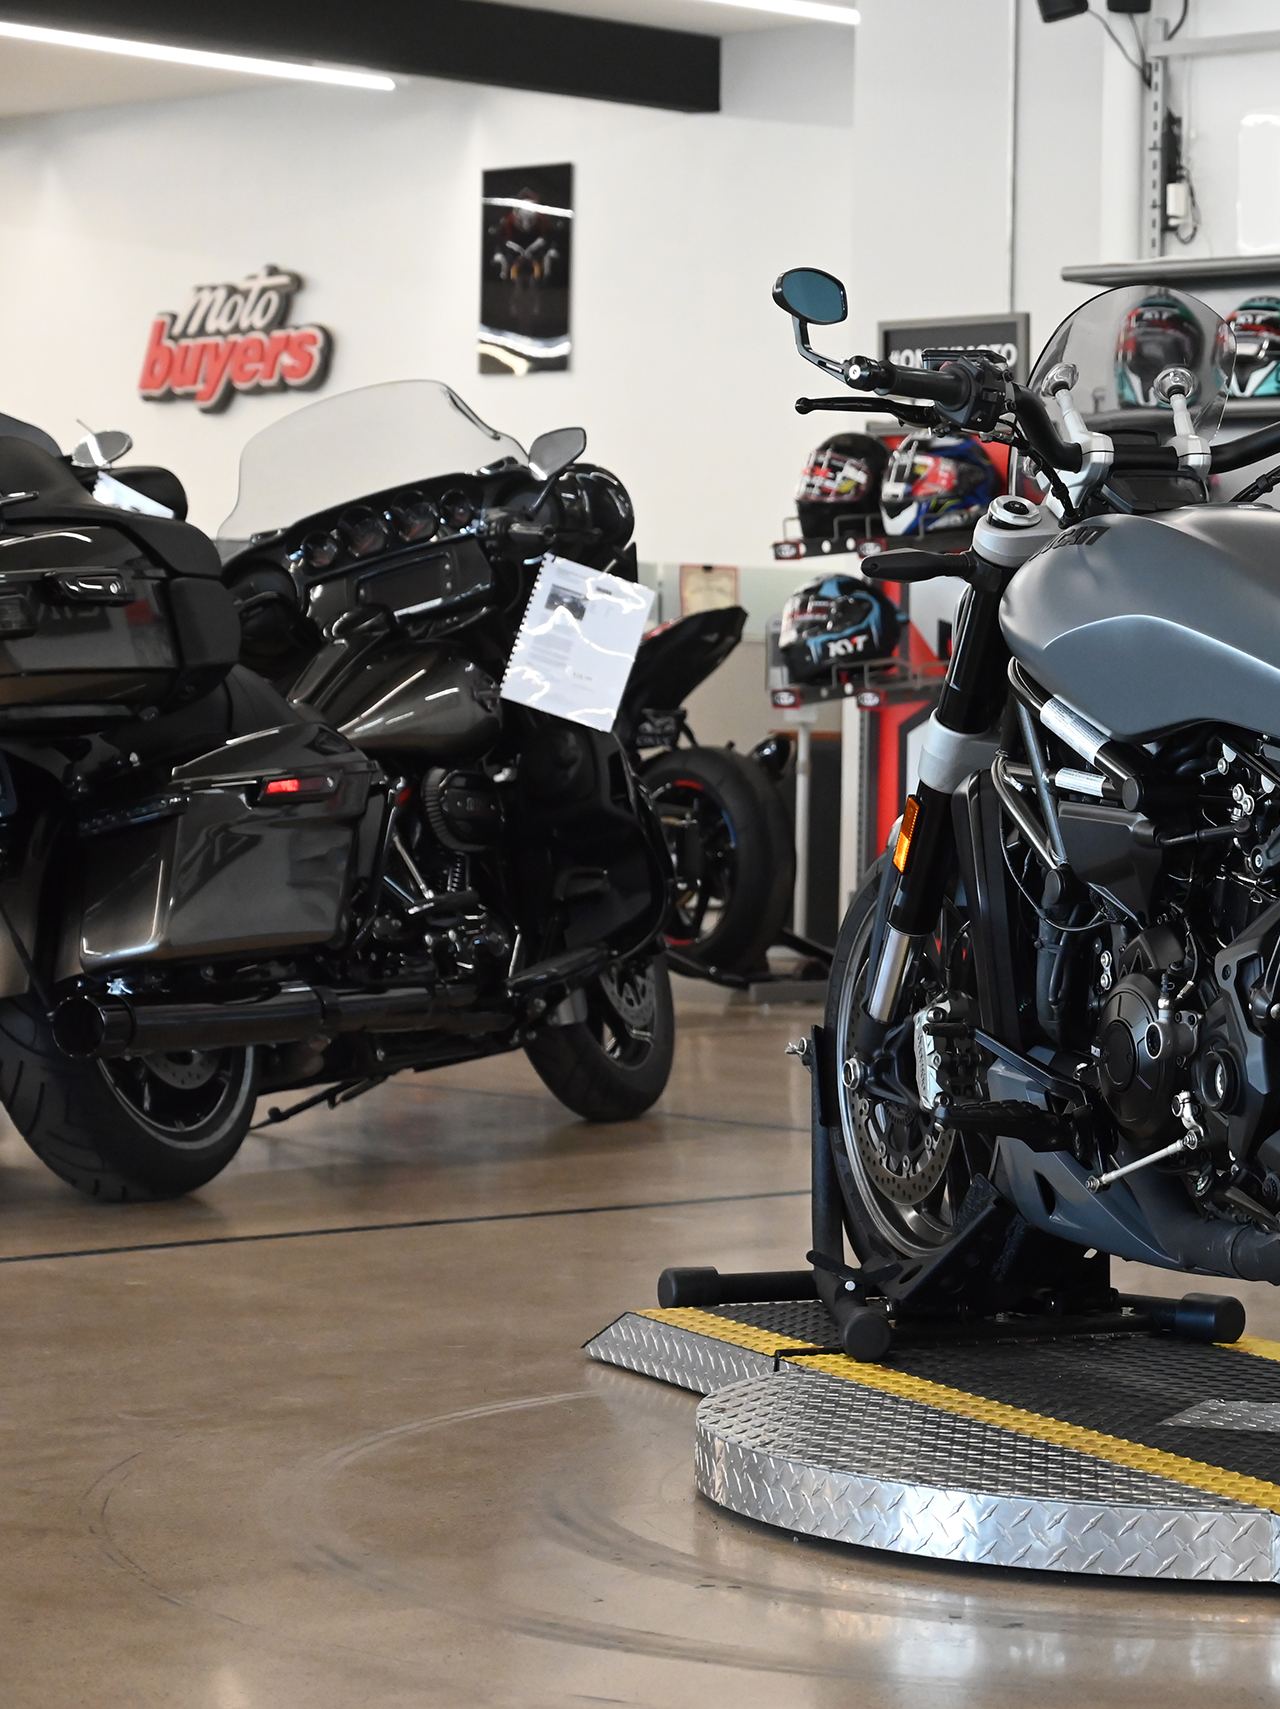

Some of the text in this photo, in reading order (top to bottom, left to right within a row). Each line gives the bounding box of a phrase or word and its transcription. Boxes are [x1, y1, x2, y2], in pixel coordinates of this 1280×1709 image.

[171, 268, 292, 336] Moto
[139, 317, 322, 407] buyers
[827, 634, 868, 658] KYT
